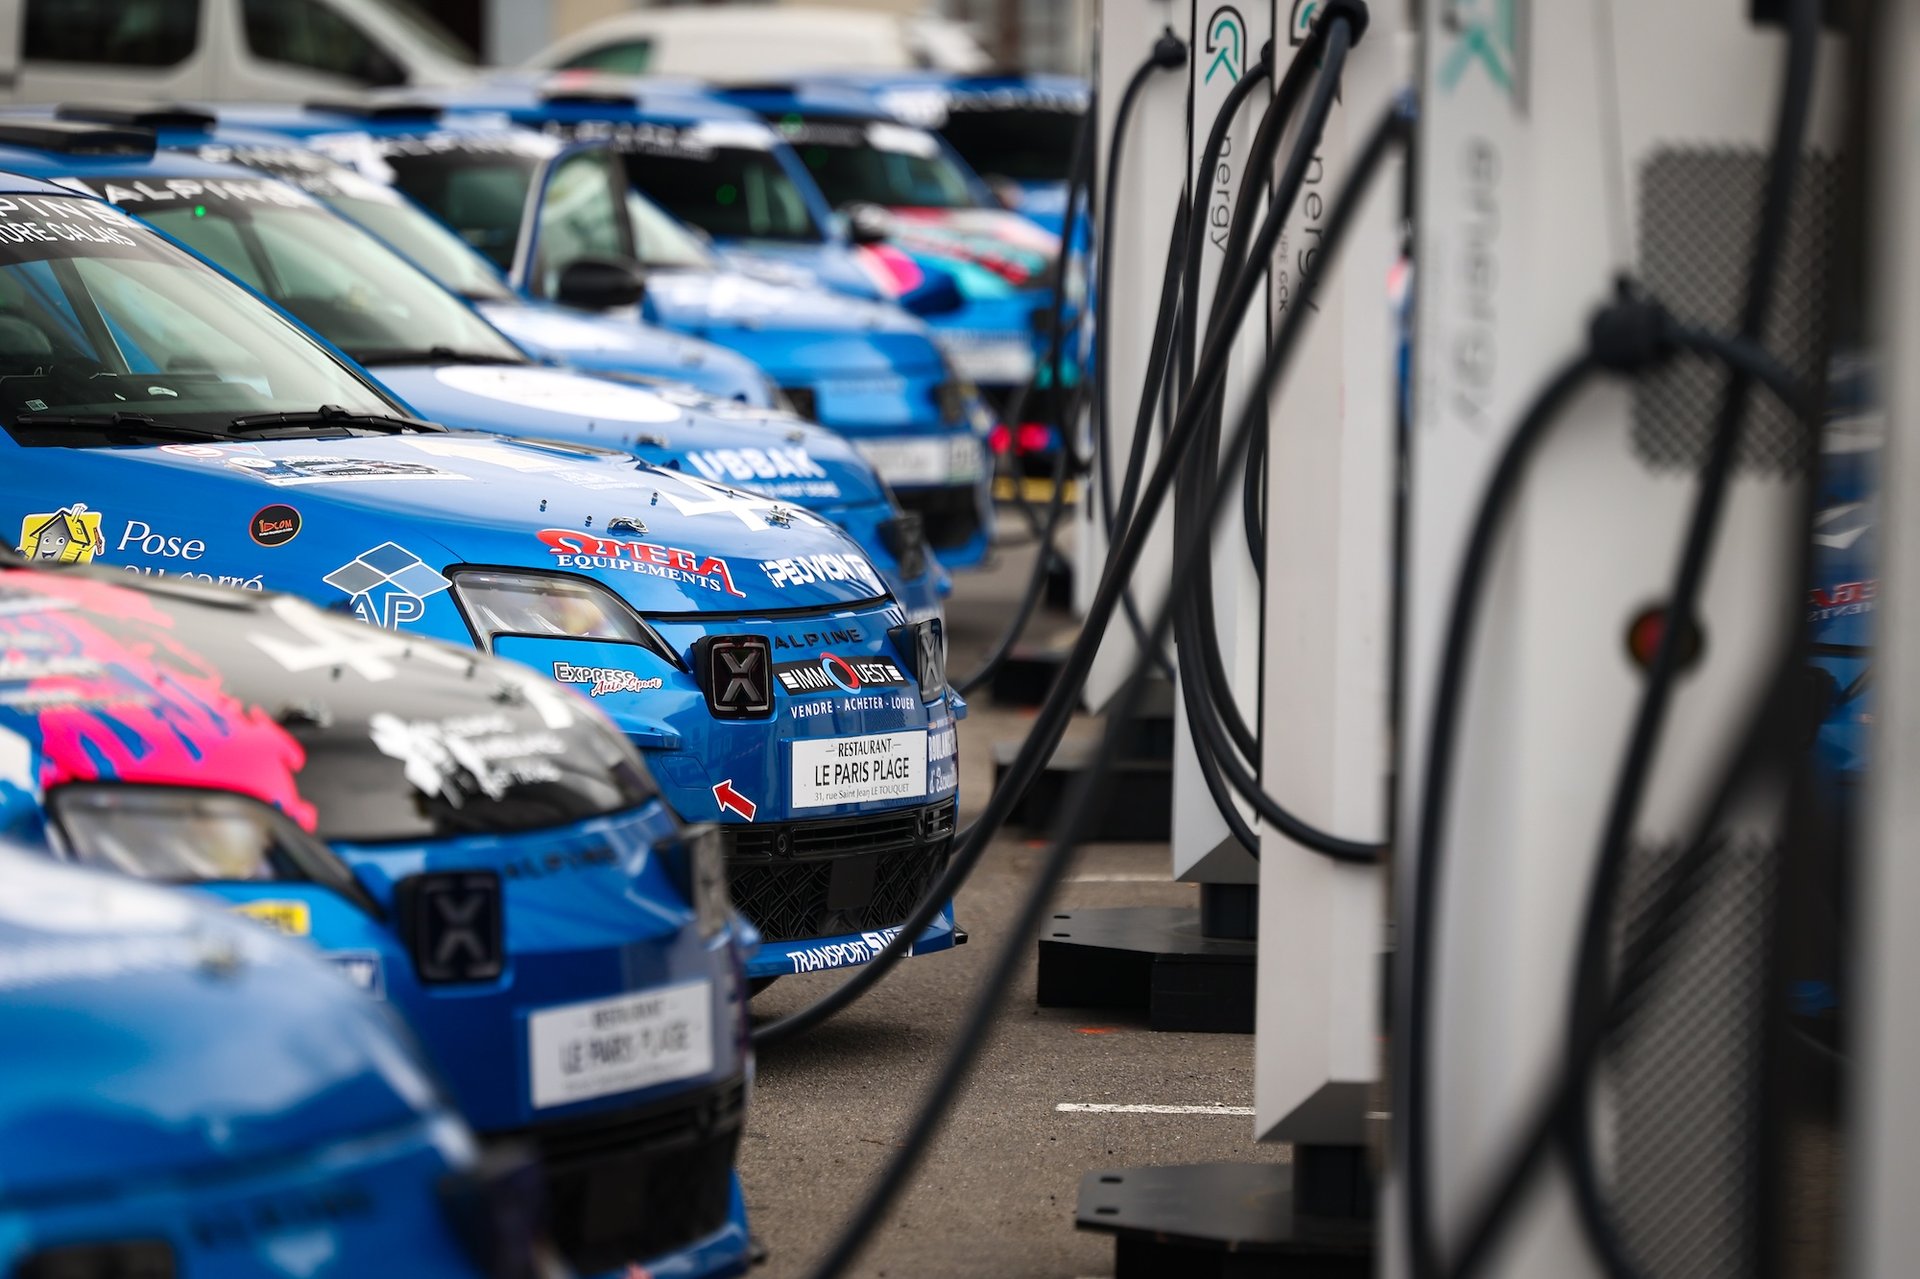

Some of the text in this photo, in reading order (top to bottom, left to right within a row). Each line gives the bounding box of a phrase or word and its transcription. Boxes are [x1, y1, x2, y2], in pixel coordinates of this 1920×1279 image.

[1210, 136, 1232, 253] nergy
[45, 221, 137, 247] CALAIS
[117, 520, 205, 560] Pose
[557, 554, 721, 592] EQUIPEMENTS
[350, 591, 425, 631] AP
[774, 629, 863, 650] ALPINE
[554, 662, 635, 683] EXPRESS
[790, 701, 833, 719] VENDRE
[844, 697, 883, 712] ACHETER
[891, 696, 915, 711] LOUER
[838, 738, 892, 757] RESTAURANT
[815, 765, 830, 787] LE
[834, 760, 869, 785] PARIS
[873, 757, 909, 781] PLAGE
[826, 792, 838, 800] rue
[839, 788, 856, 800] Saint
[857, 788, 870, 799] Jean
[871, 786, 878, 796] LE
[879, 783, 909, 796] TOUQUET
[786, 940, 870, 973] TRANSPORT
